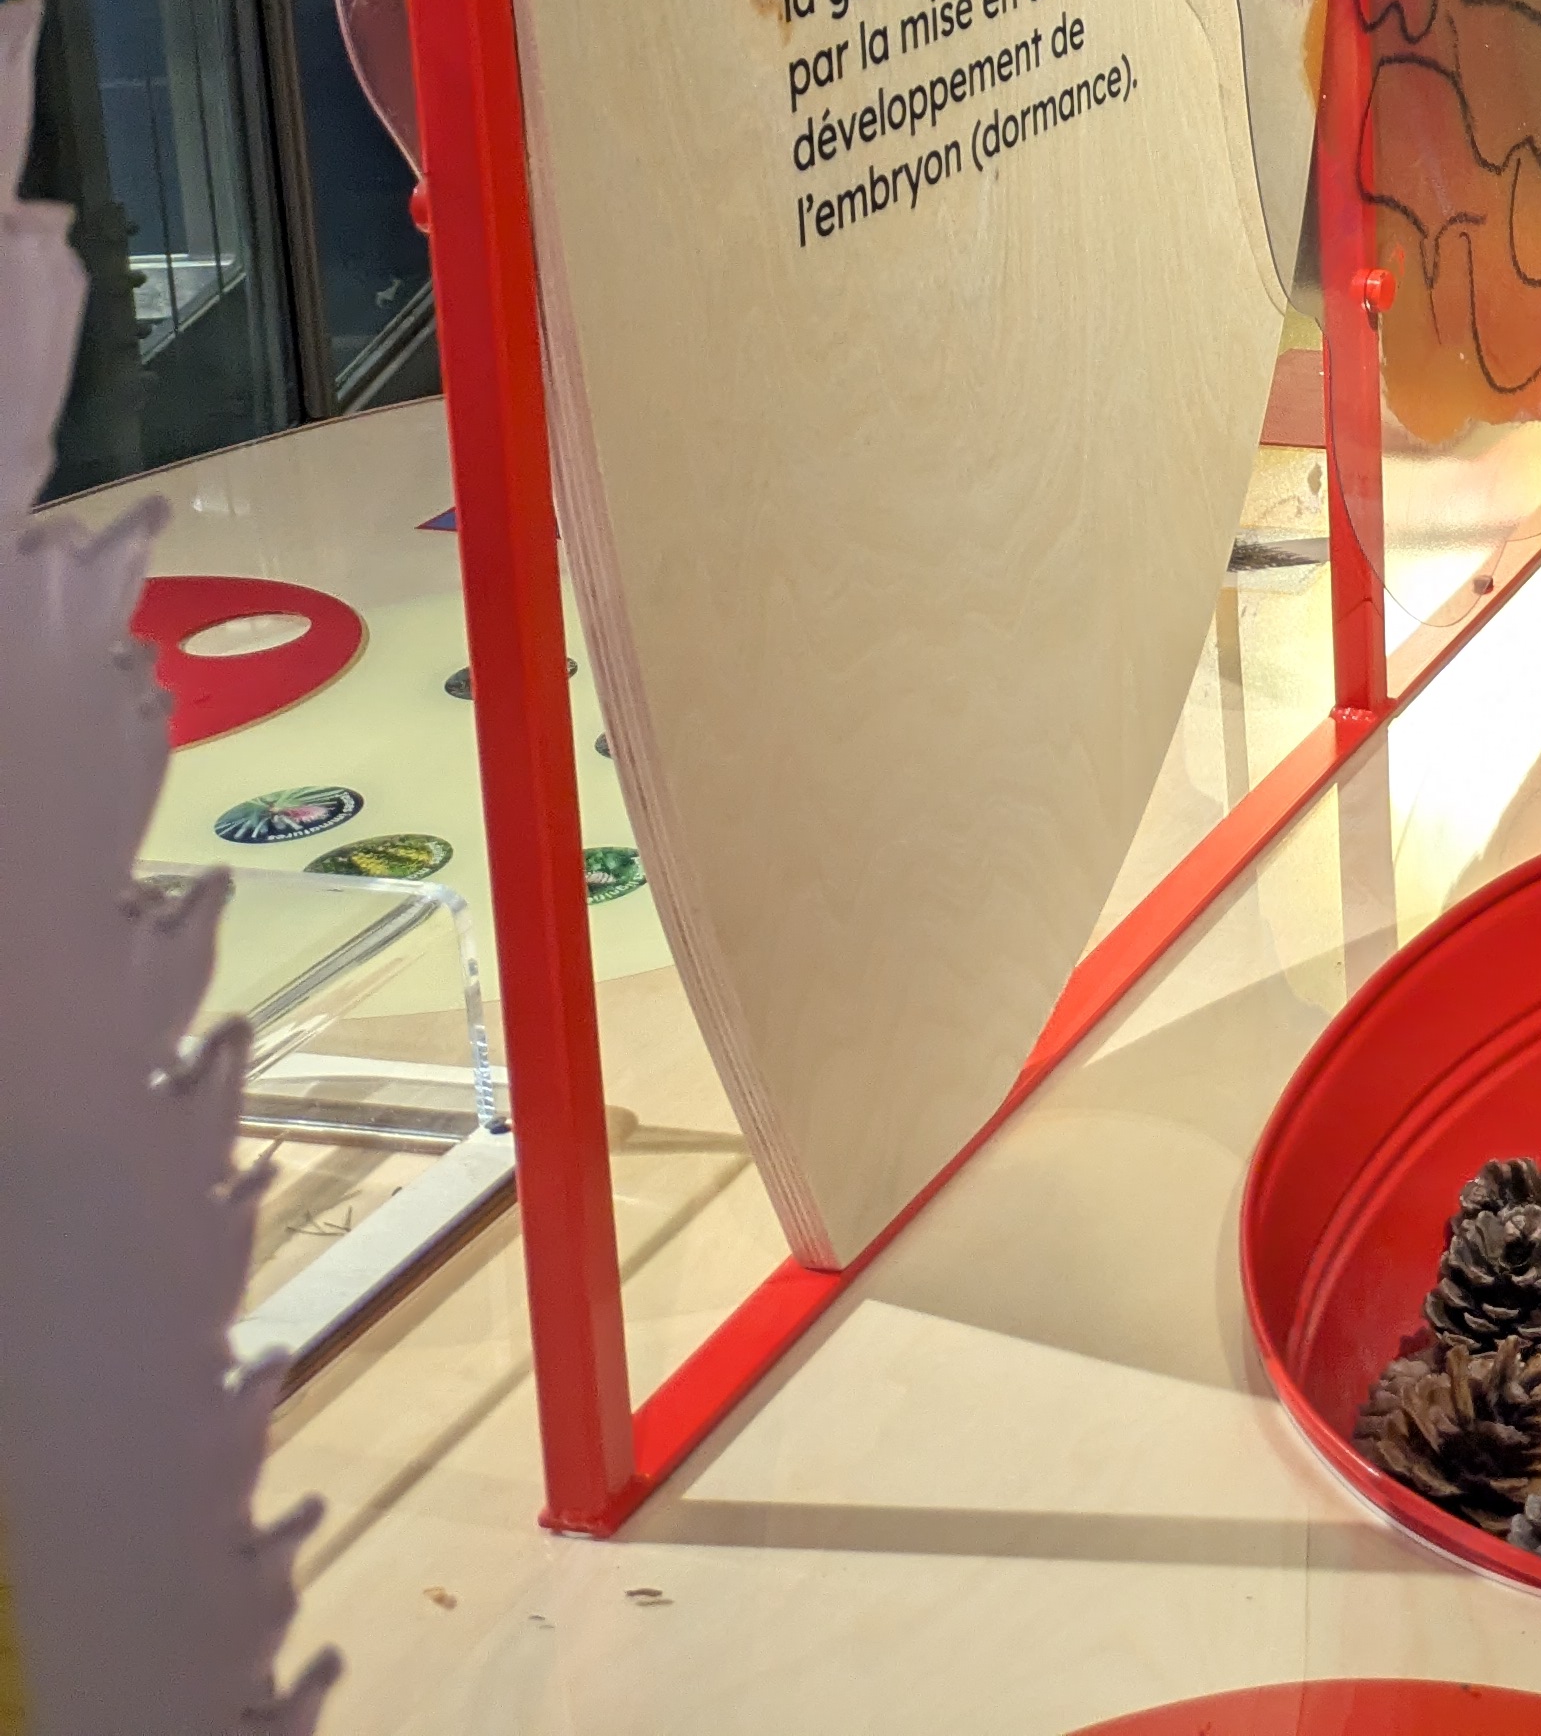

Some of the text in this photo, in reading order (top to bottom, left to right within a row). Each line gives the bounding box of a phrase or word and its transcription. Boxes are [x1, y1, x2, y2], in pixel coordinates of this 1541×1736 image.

[788, 39, 849, 114] par
[859, 20, 890, 71] la
[793, 11, 1085, 172] développement de
[797, 53, 1138, 248] l’embryon (dormance).
